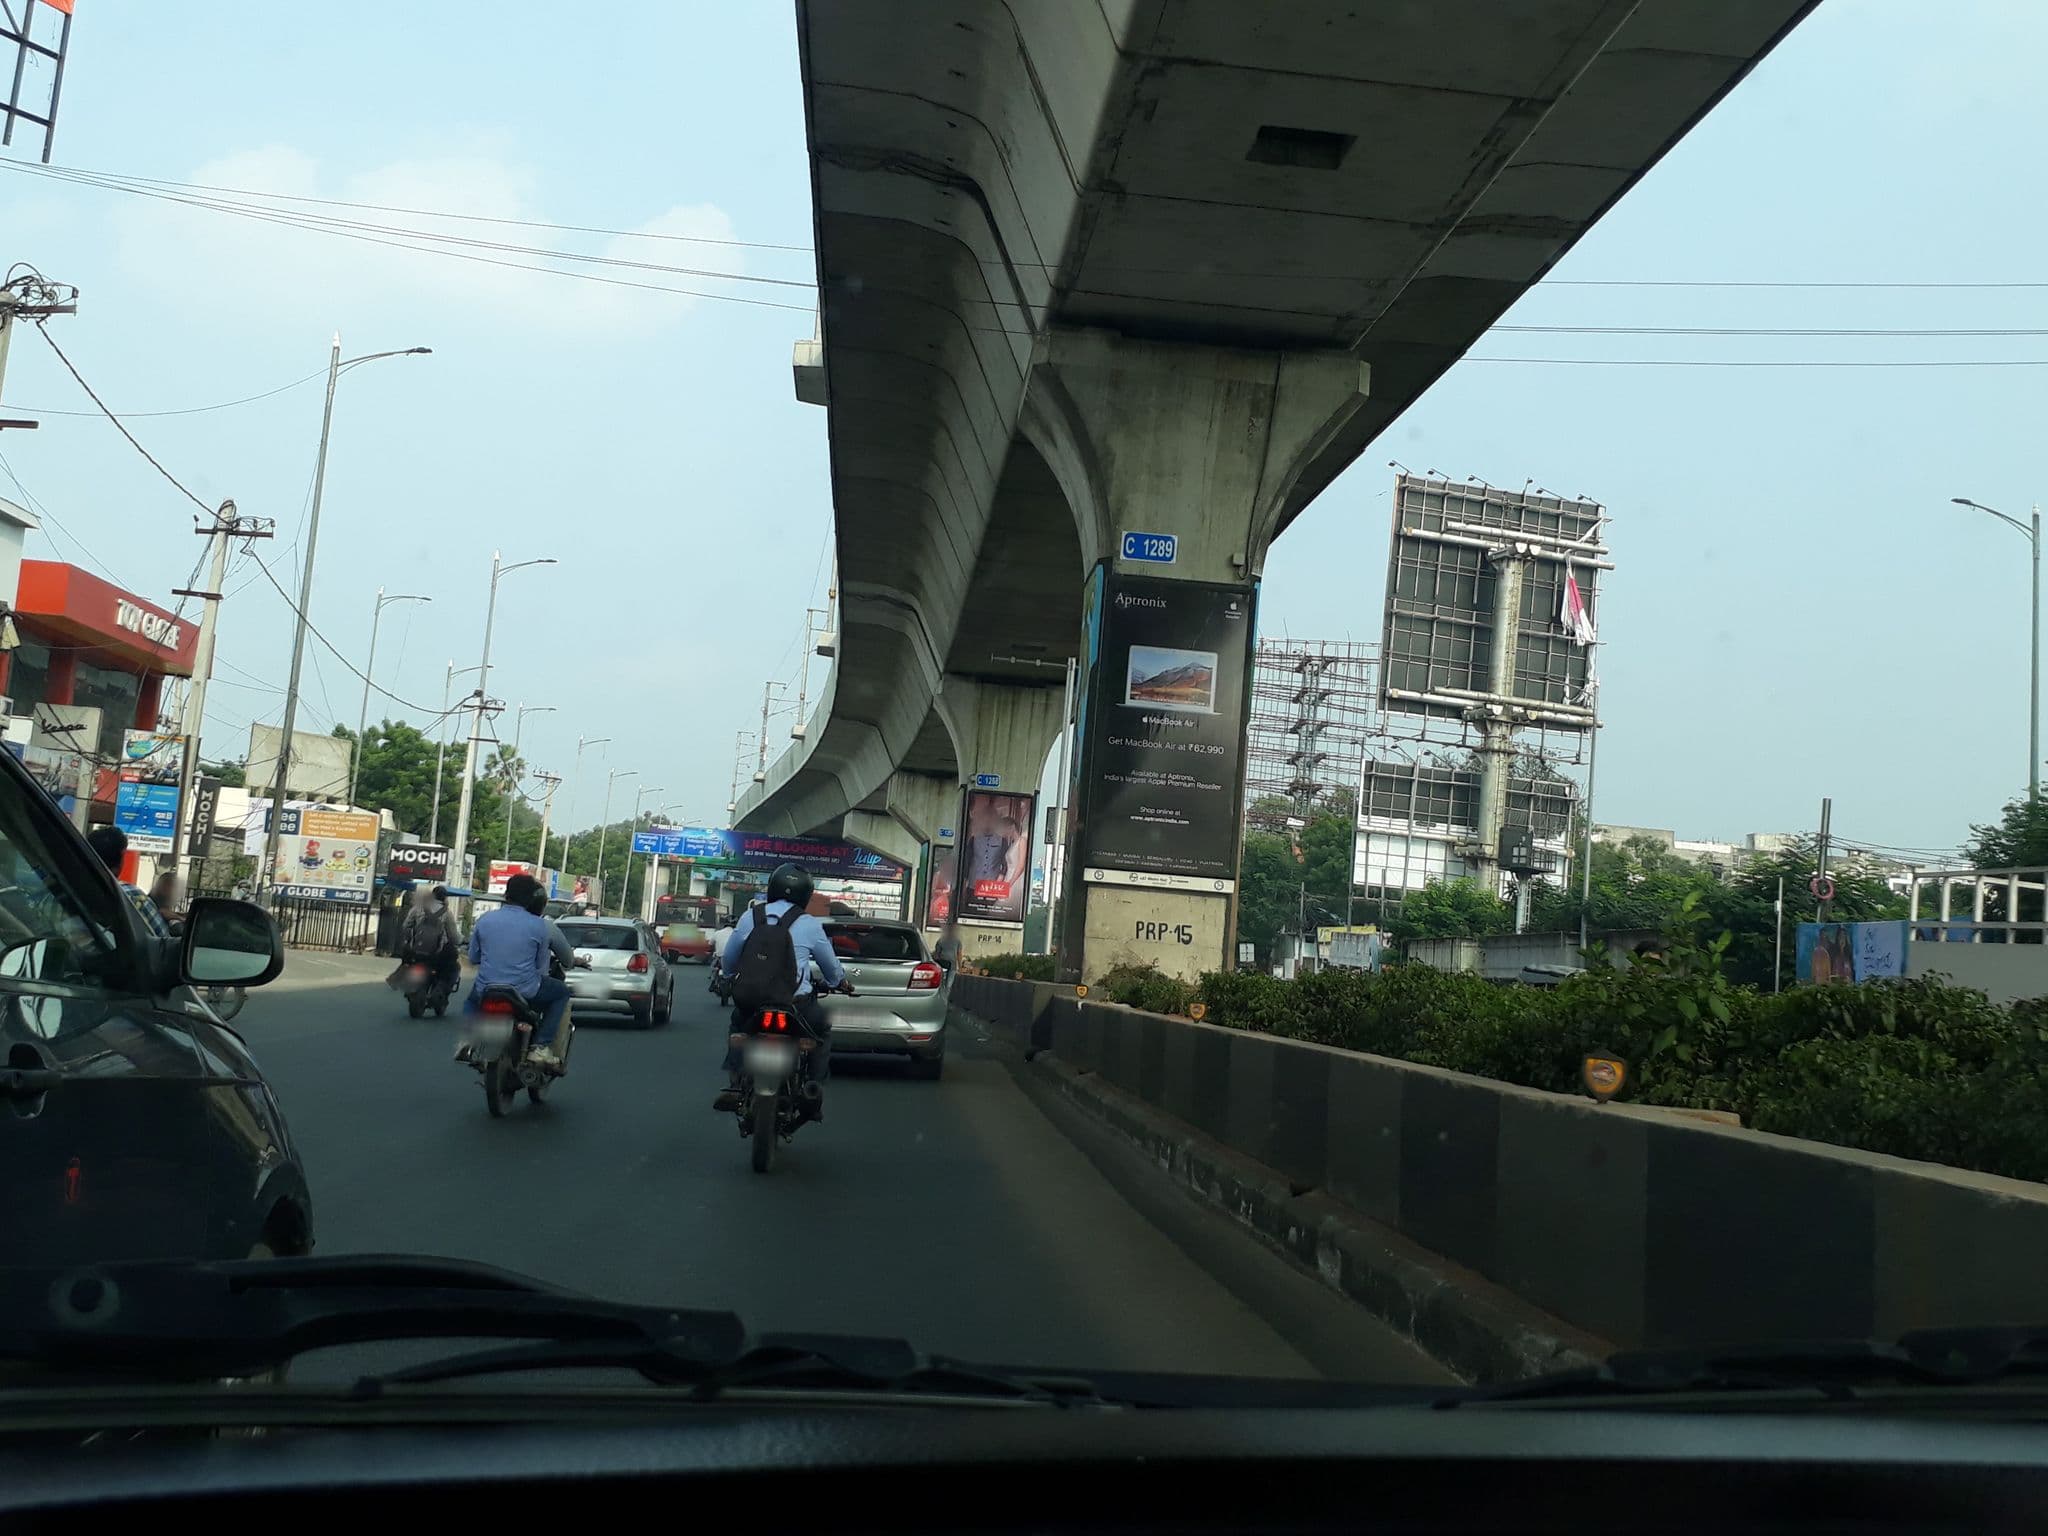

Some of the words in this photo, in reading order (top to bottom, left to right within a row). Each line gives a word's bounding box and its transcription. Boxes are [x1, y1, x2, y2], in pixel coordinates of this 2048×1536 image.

[1126, 537, 1136, 554] C
[1144, 539, 1173, 558] 1289
[1114, 591, 1167, 609] Aptronix
[116, 598, 144, 634] TOY
[1149, 715, 1182, 727] MacBook
[1184, 719, 1195, 728] Air
[1108, 736, 1123, 746] Get
[1125, 738, 1163, 750] MacBook
[1165, 742, 1176, 751] Air
[1178, 743, 1186, 752] at
[1167, 779, 1195, 789] Premium
[1196, 781, 1222, 791] Reseller
[196, 789, 214, 846] MOCHI
[1140, 805, 1156, 815] Shop
[1156, 807, 1172, 816] online
[744, 838, 771, 851] LIFE
[391, 847, 447, 865] MOCHI
[287, 886, 326, 899] GLOBE
